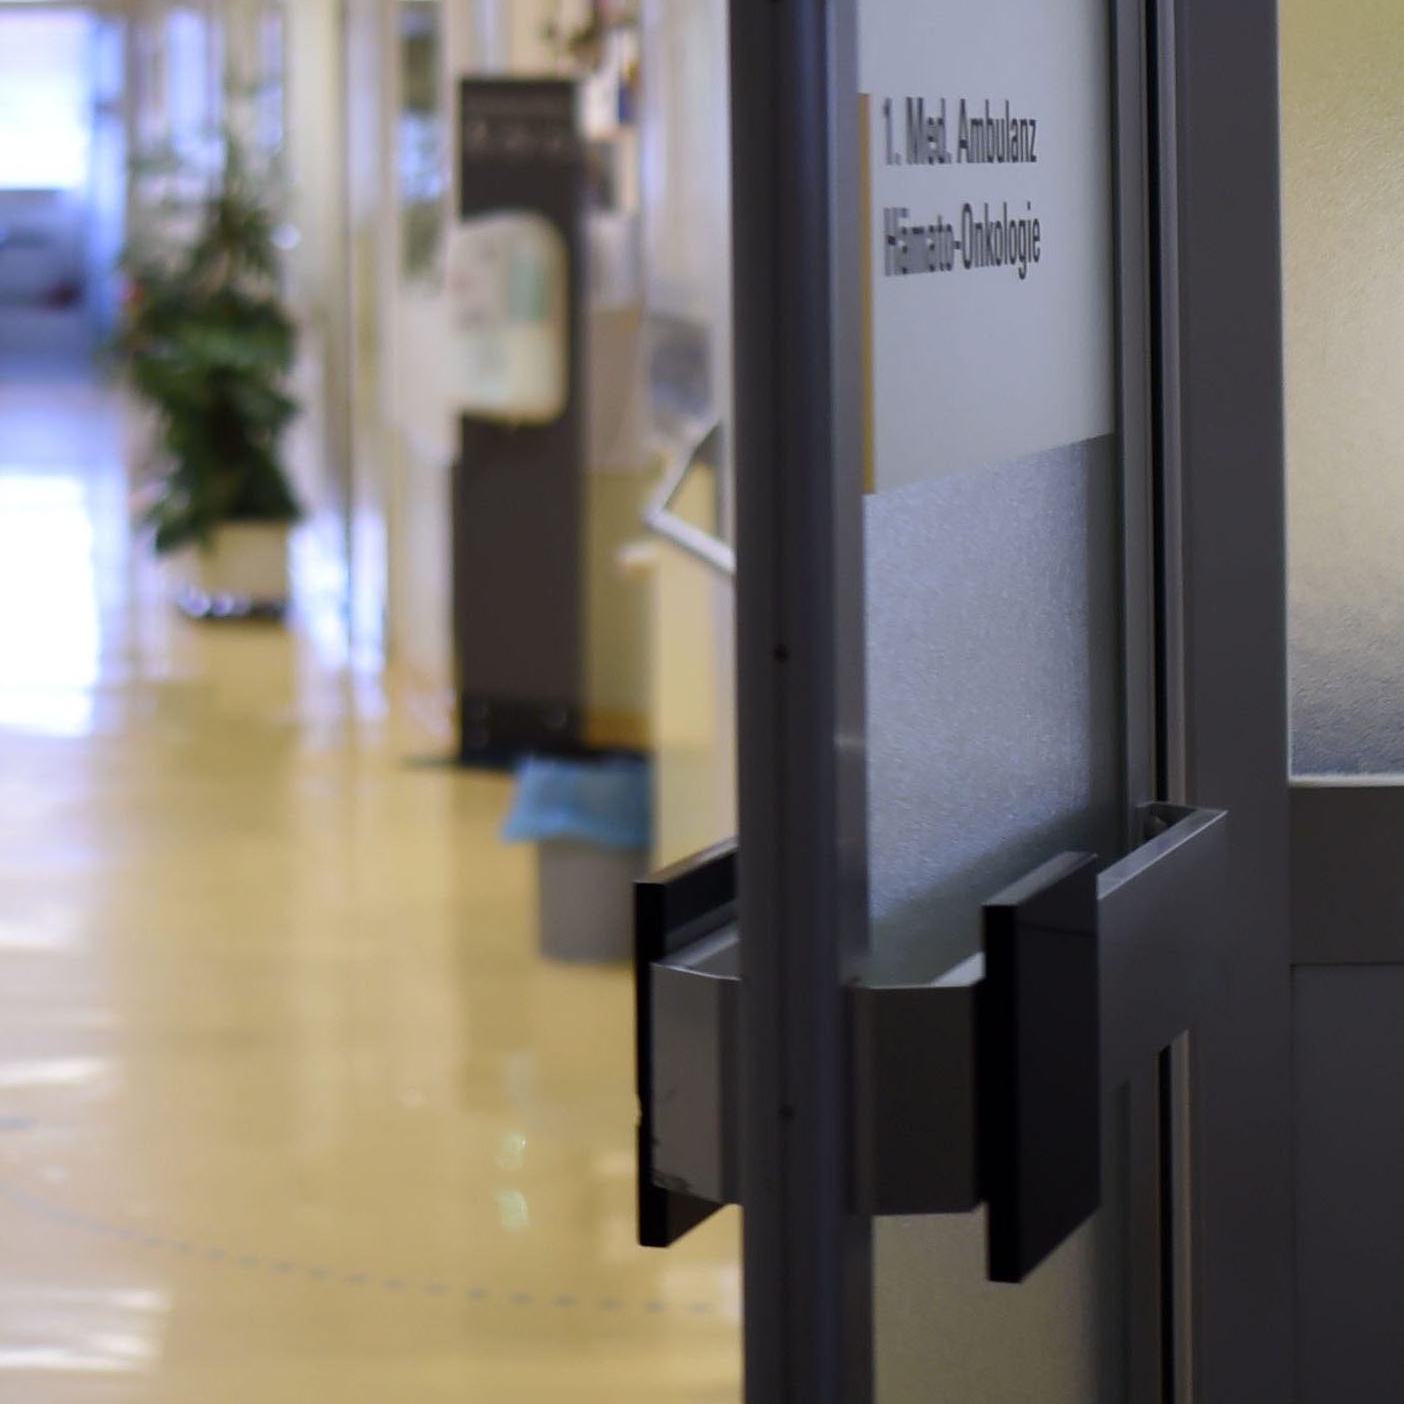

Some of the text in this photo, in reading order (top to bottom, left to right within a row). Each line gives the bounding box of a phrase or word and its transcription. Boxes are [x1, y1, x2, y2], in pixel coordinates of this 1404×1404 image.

[882, 96, 1037, 165] 1. Med. Ambulanz
[883, 201, 1041, 280] Hämato-Onkologie
